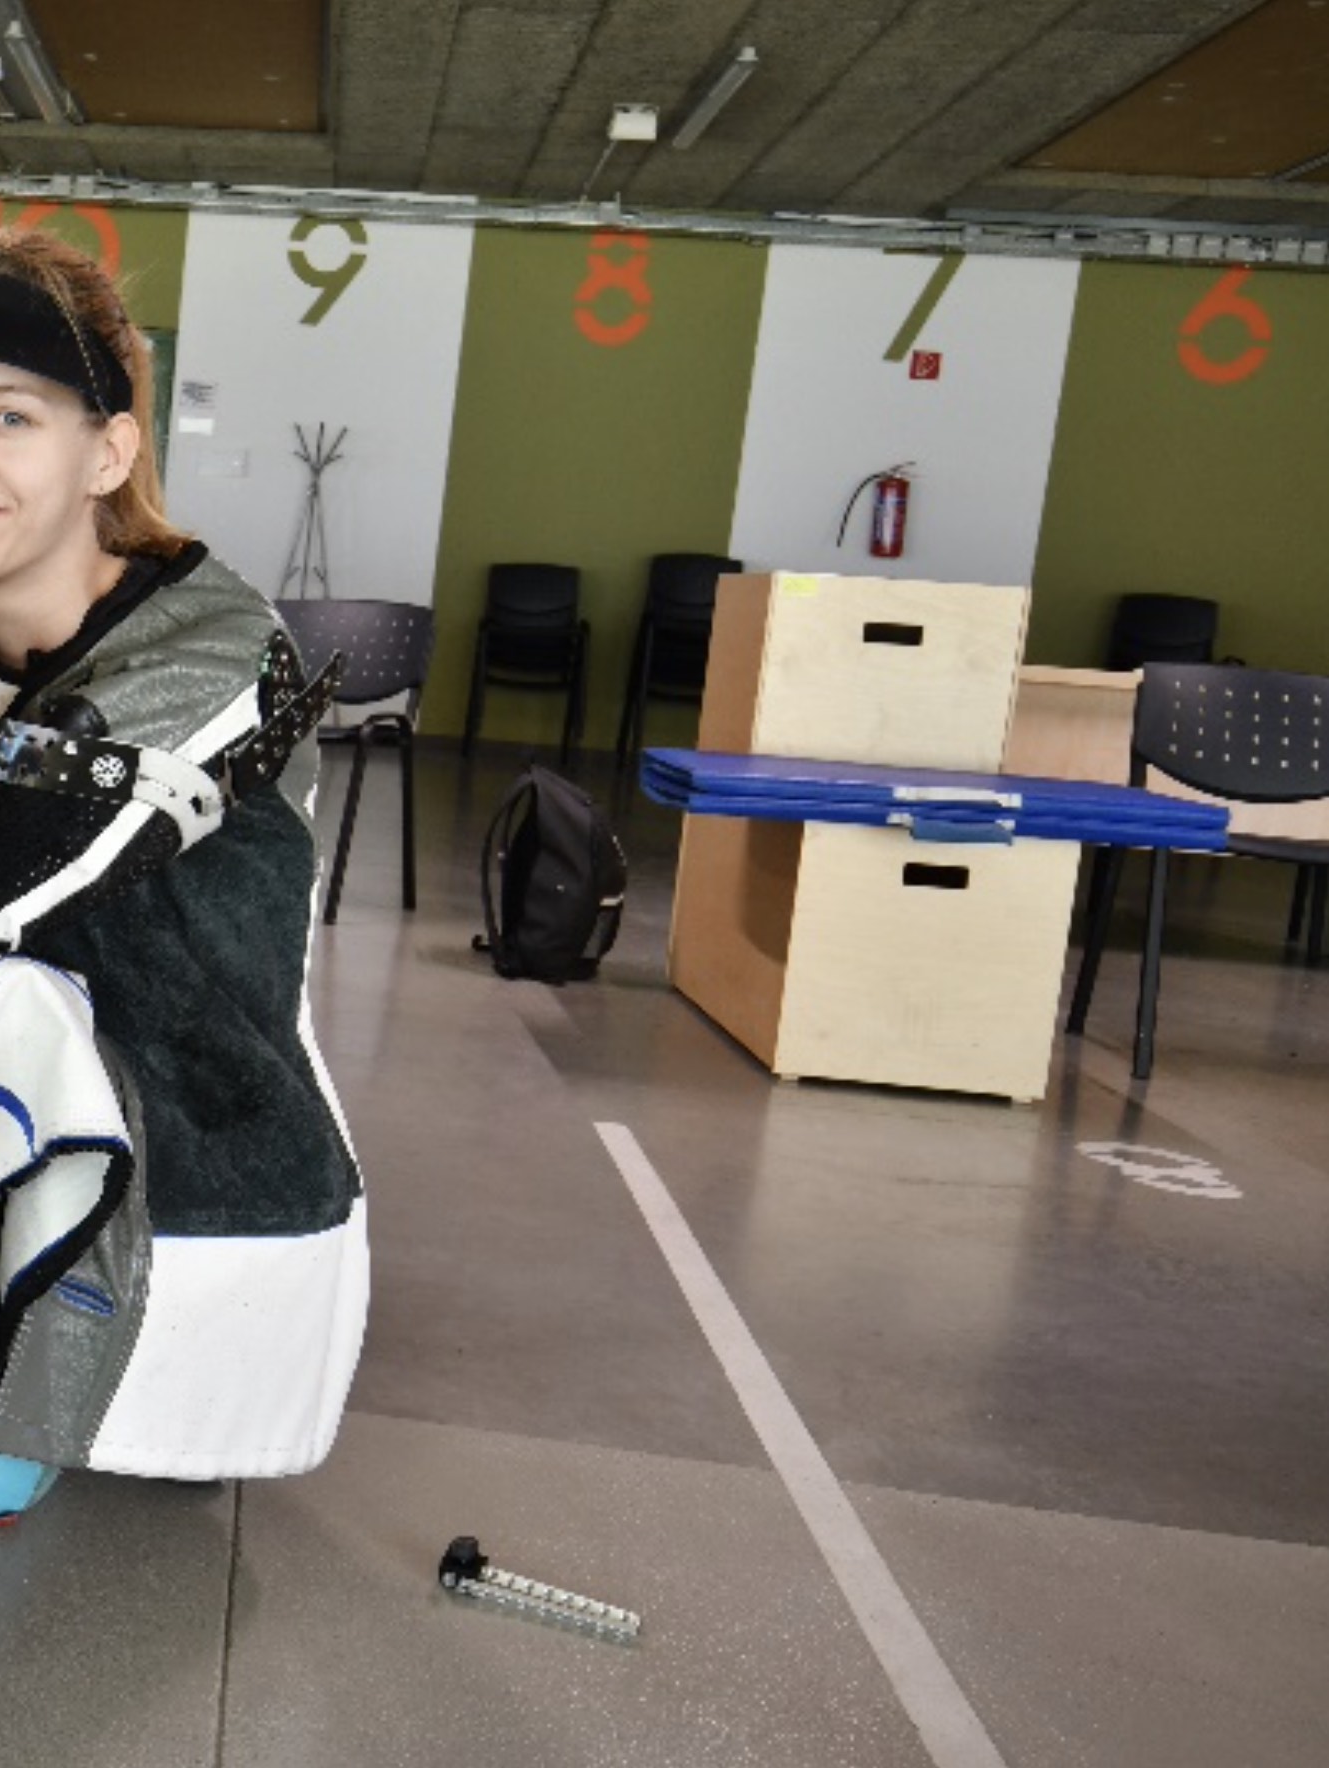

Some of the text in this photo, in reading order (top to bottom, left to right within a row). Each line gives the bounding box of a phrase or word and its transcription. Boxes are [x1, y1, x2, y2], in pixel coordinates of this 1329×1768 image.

[287, 208, 368, 327] 9
[573, 228, 654, 349] 8
[882, 247, 967, 362] 7
[1177, 262, 1273, 386] 6
